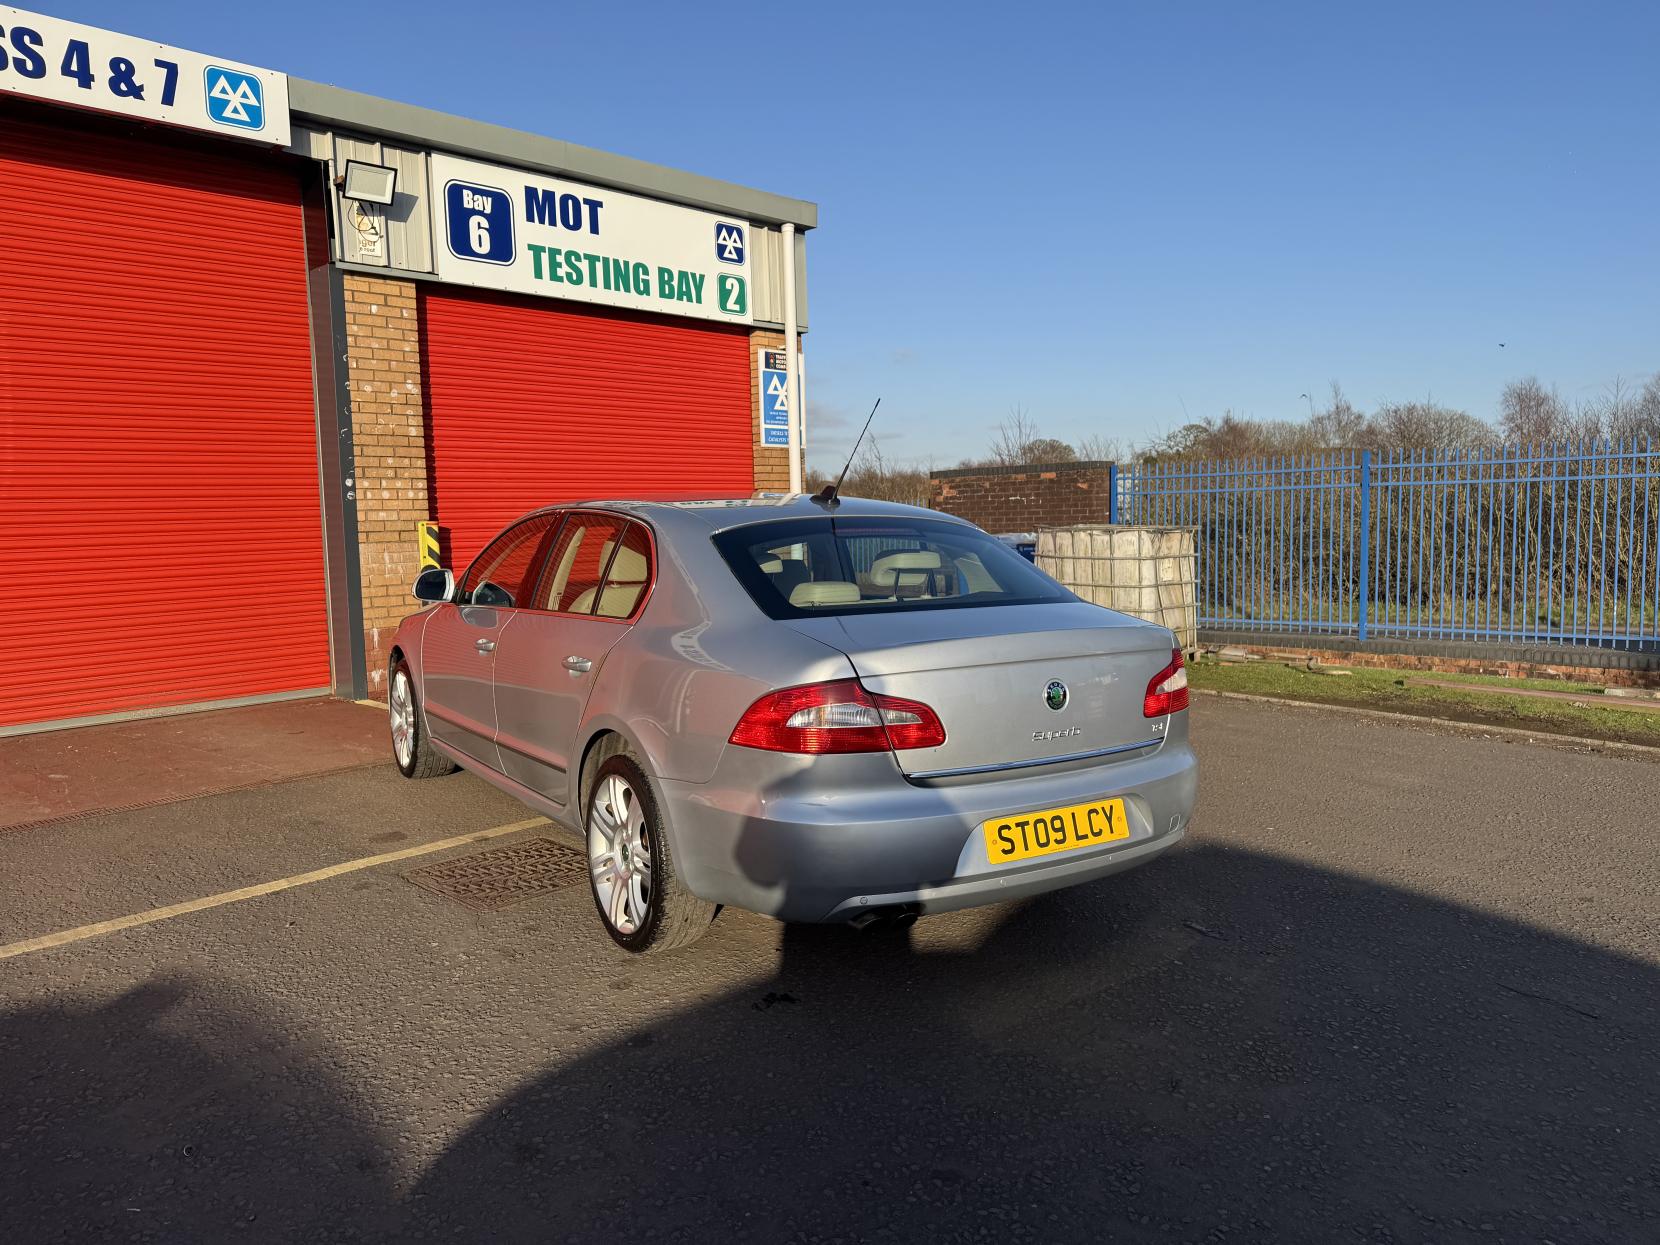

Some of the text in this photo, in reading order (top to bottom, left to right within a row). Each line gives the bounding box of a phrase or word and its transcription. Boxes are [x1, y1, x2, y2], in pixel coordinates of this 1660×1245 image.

[61, 39, 95, 90] 4
[108, 56, 145, 101] &
[154, 58, 179, 107] 7
[462, 189, 492, 213] Bay
[524, 185, 603, 235] MOT
[469, 215, 491, 255] 6
[527, 244, 705, 304] TESTING BAY
[724, 278, 740, 311] 2
[1032, 726, 1080, 741] Superb
[997, 805, 1114, 855] ST09 LCY
